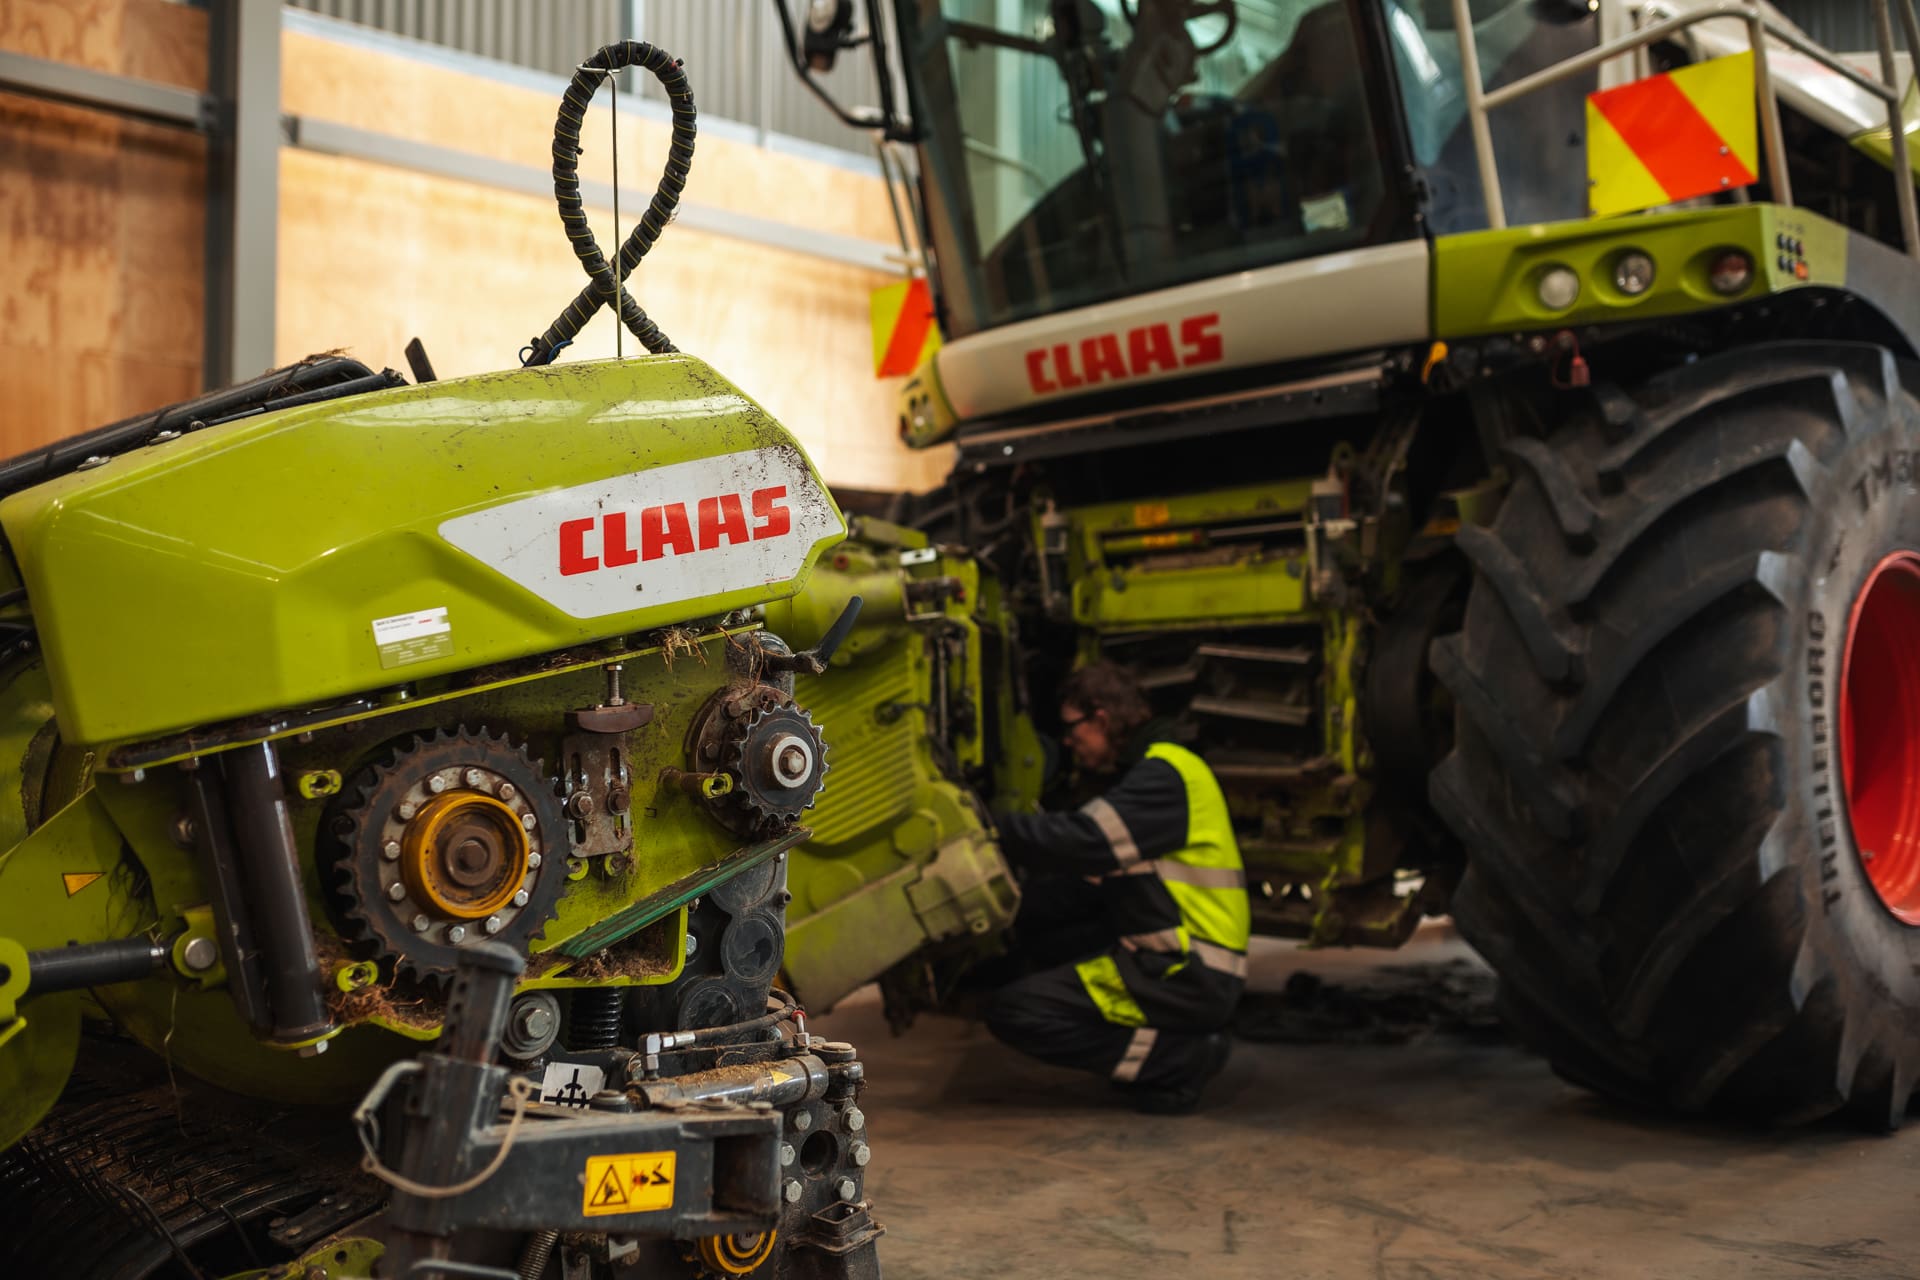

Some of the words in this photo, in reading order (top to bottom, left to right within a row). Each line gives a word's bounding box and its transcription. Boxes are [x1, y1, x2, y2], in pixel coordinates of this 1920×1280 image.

[1026, 313, 1223, 395] CLAAS
[559, 485, 791, 577] CLAAS
[1807, 610, 1842, 915] TRELLEBORG
